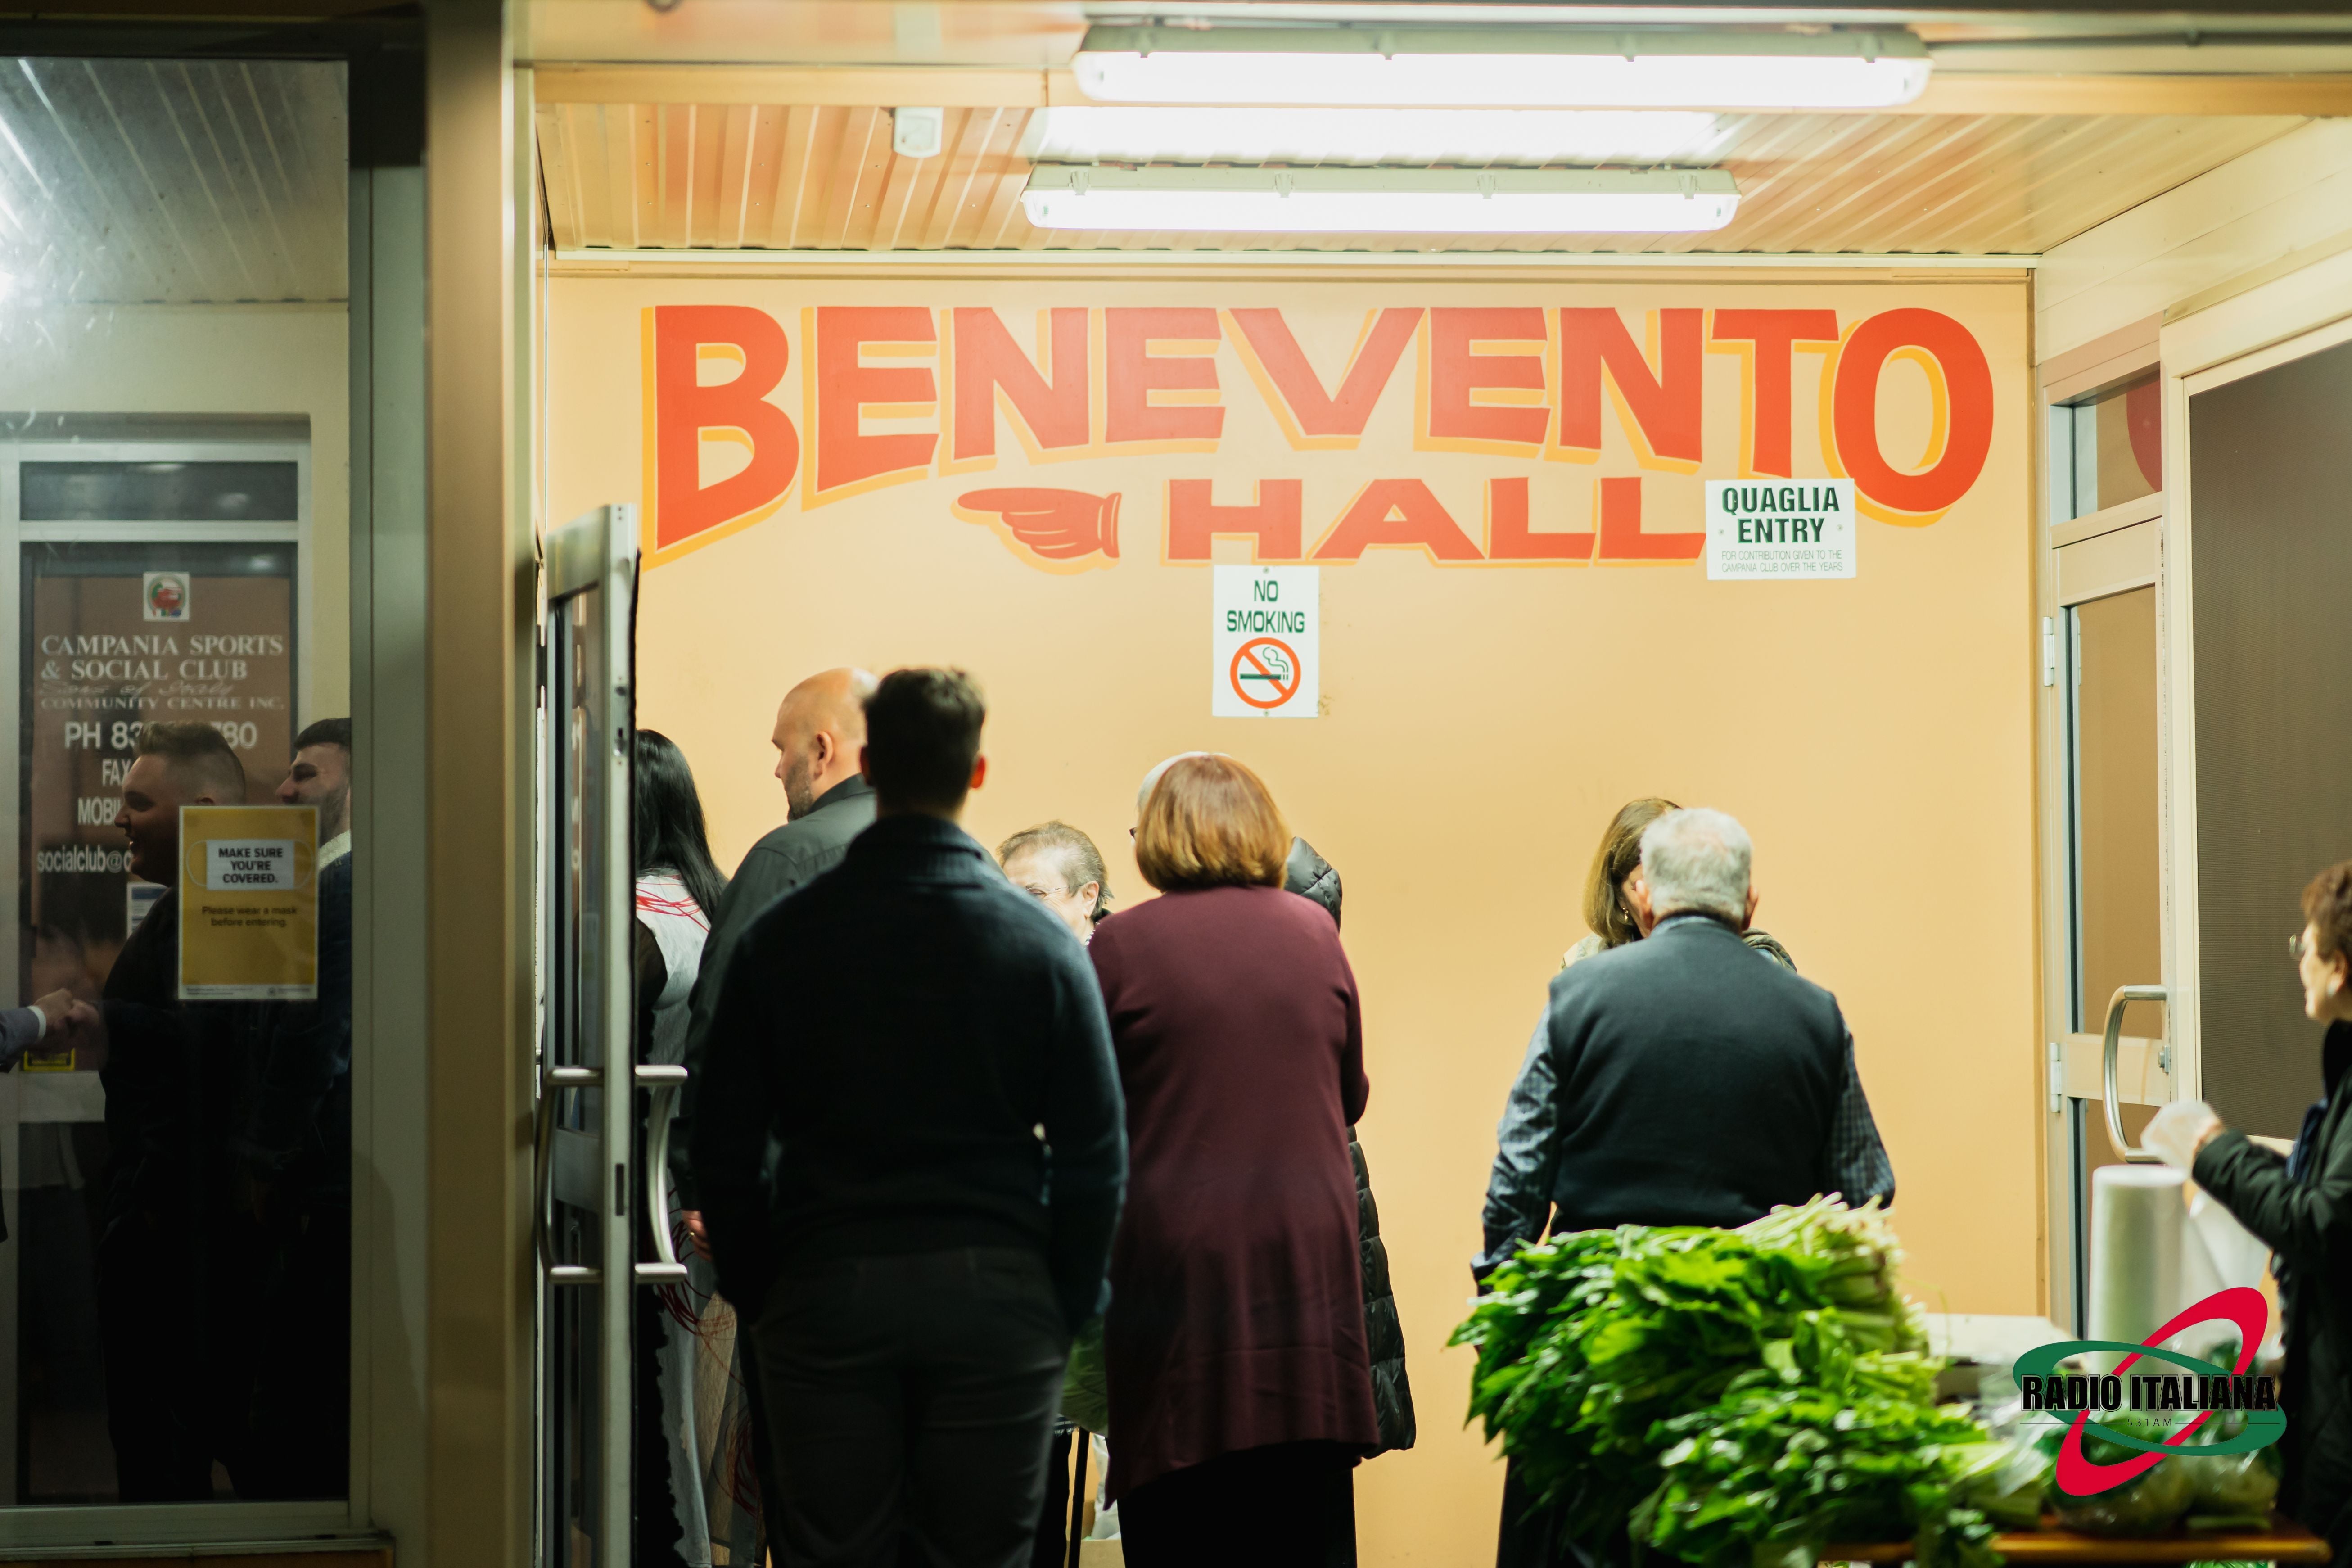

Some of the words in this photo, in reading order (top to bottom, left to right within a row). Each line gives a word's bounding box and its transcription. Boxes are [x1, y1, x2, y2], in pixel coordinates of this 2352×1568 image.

[641, 305, 1994, 573] BENEVENTO
[1721, 487, 1840, 516] QUAGLIA
[1160, 476, 1706, 567] HALL
[1738, 518, 1825, 543] ENTRY
[1722, 551, 1736, 560] FOR
[1738, 550, 1791, 560] CONTRIBUTION
[1793, 550, 1814, 560] GIVEN
[1816, 550, 1826, 559] TO
[1828, 550, 1842, 559] THE
[1722, 563, 1757, 572] CAMPANIA
[1760, 562, 1778, 572] CLUB
[1781, 562, 1800, 572] OVER
[1802, 562, 1816, 571] THE
[1819, 562, 1843, 571] YEARS
[1254, 580, 1278, 602] NO
[1226, 610, 1305, 633] SMOKING
[41, 634, 179, 656] CAMPANIA
[190, 634, 283, 656] SPORTS
[41, 660, 61, 680] &
[72, 659, 168, 681] SOCIAL
[180, 659, 248, 680] CLUB
[41, 697, 161, 710] COMMUNITY
[167, 697, 242, 710] CENTRE
[64, 721, 101, 750] PH
[102, 758, 131, 786] FAX
[218, 848, 251, 858] MAKE
[254, 848, 283, 858] SURE
[231, 860, 271, 871] YOU'RE
[223, 873, 278, 883] COVERED.
[202, 906, 234, 914] Please
[271, 906, 297, 914] mask
[211, 918, 243, 926] before
